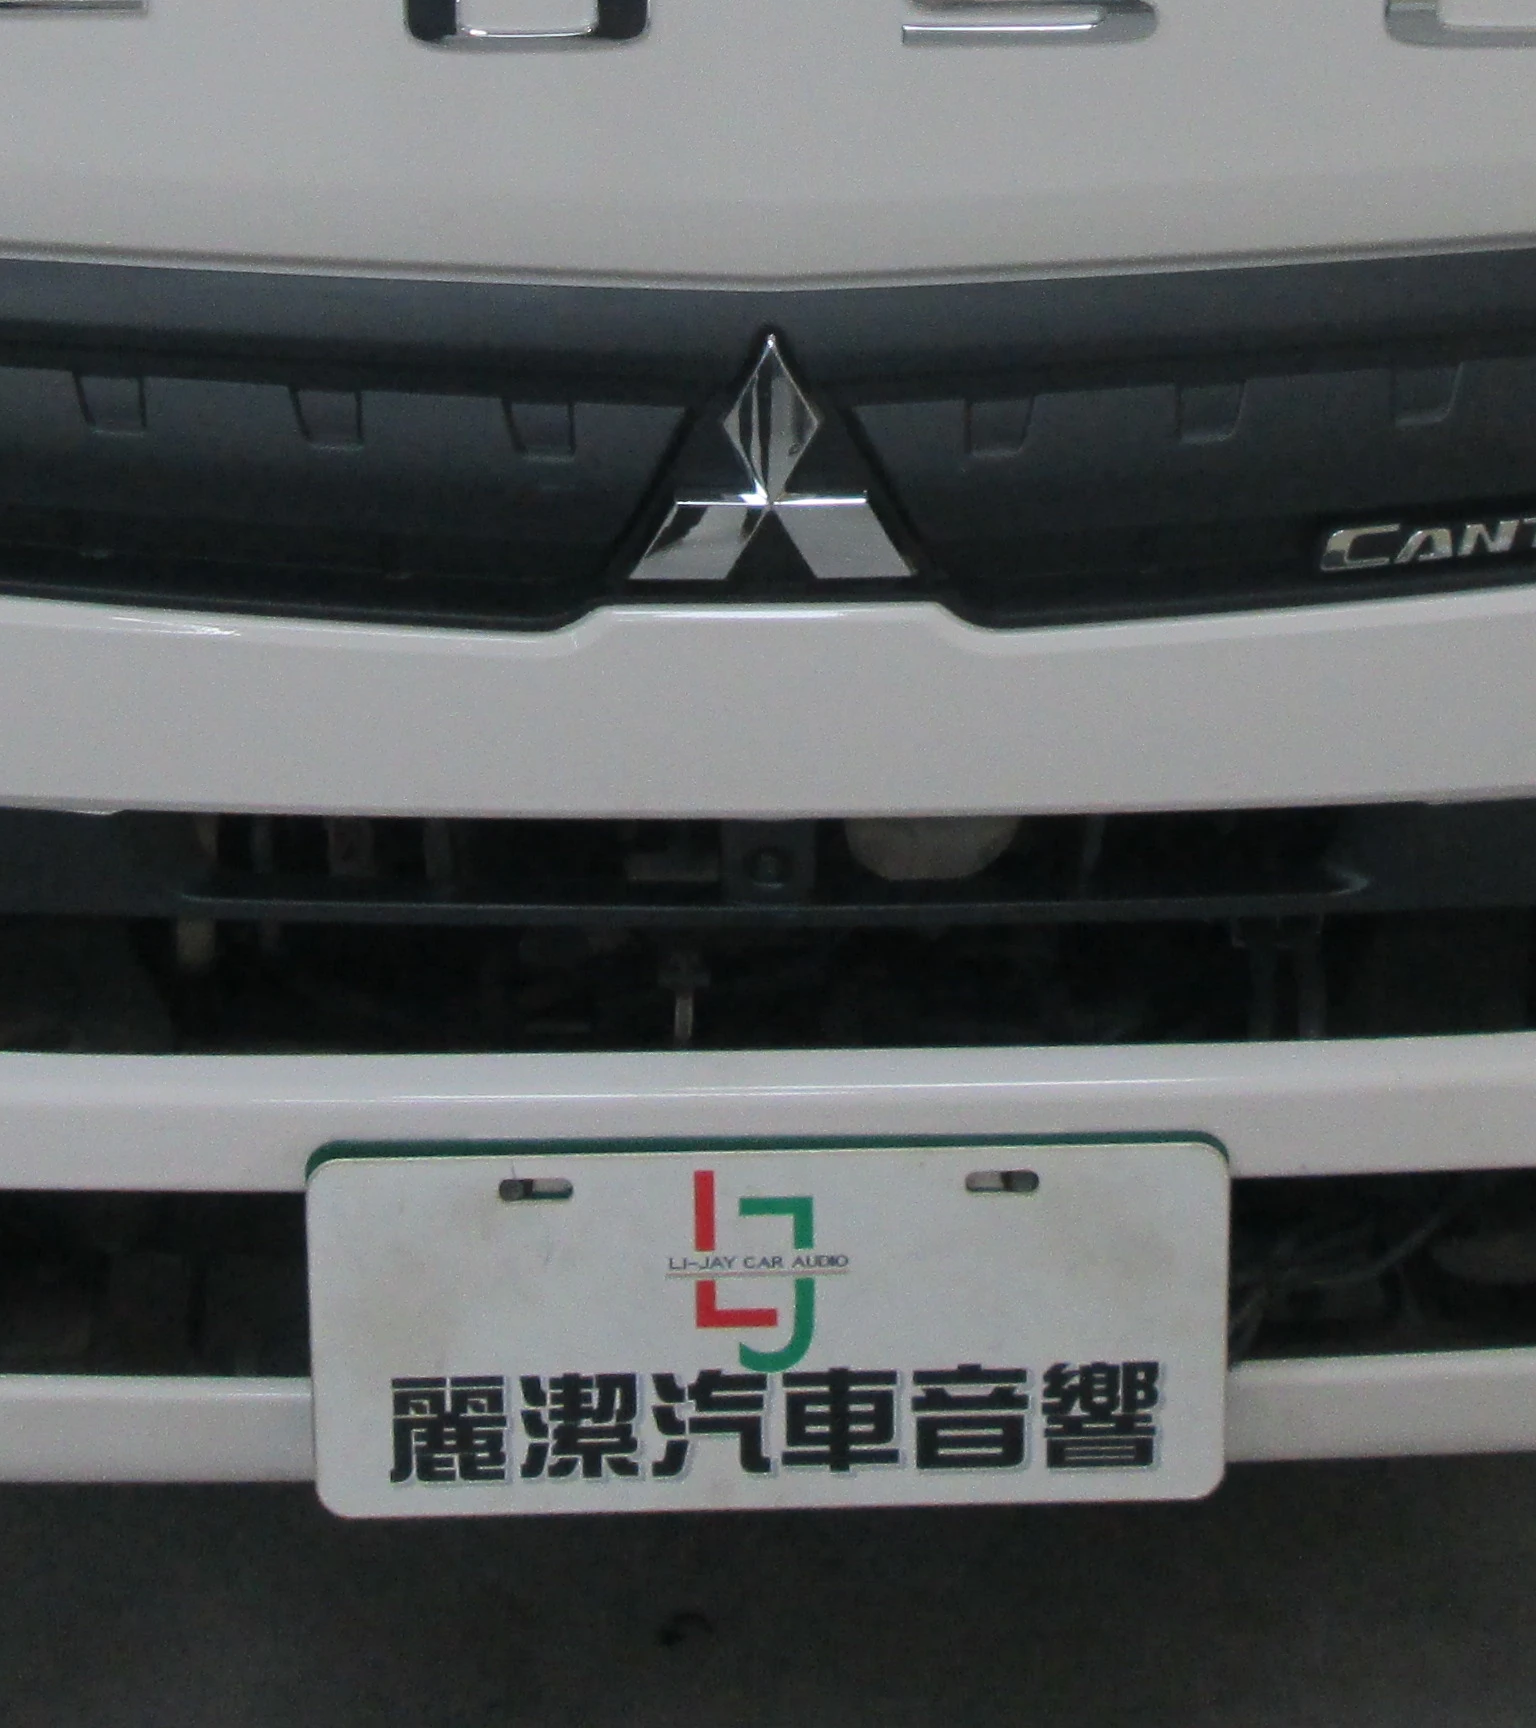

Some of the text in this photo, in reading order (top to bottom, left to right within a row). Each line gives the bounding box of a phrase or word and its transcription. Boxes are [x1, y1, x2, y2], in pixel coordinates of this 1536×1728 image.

[668, 1253, 850, 1270] LI-JAY CAR AUDIO
[389, 1361, 1161, 1483] 麗潔汽車音響
